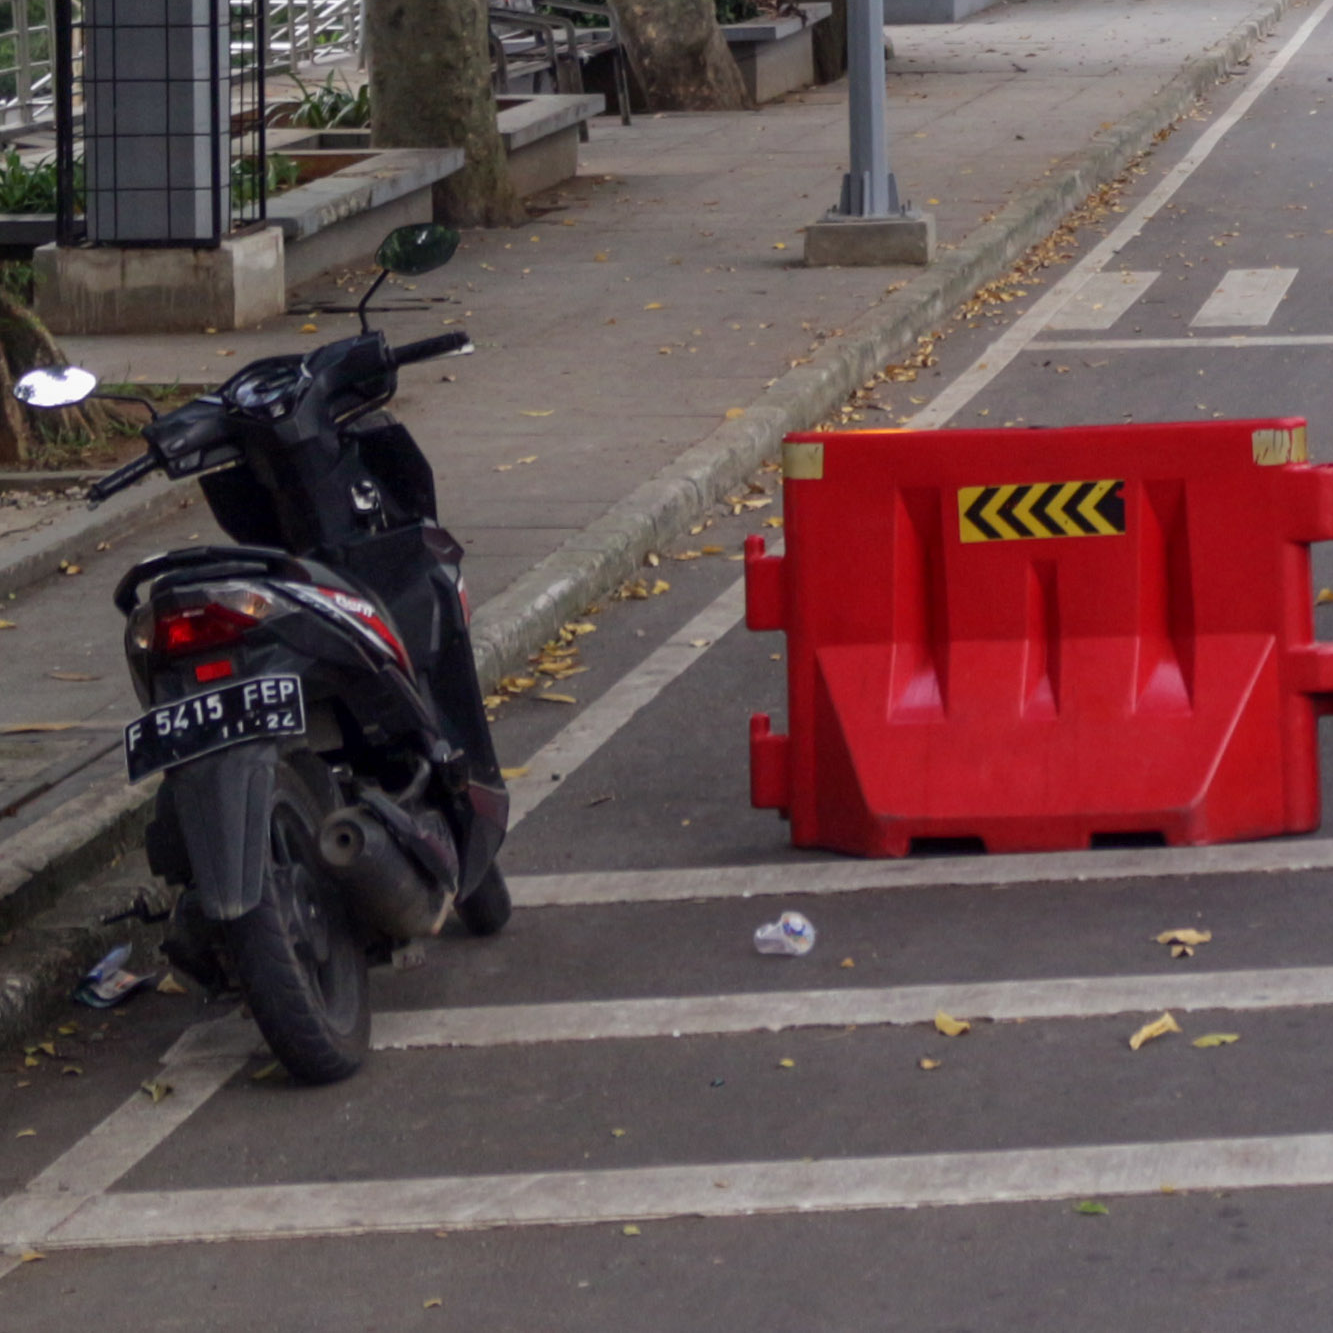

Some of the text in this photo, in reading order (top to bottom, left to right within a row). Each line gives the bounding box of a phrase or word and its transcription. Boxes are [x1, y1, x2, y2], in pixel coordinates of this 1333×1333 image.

[128, 679, 294, 752] F 5415 FEP
